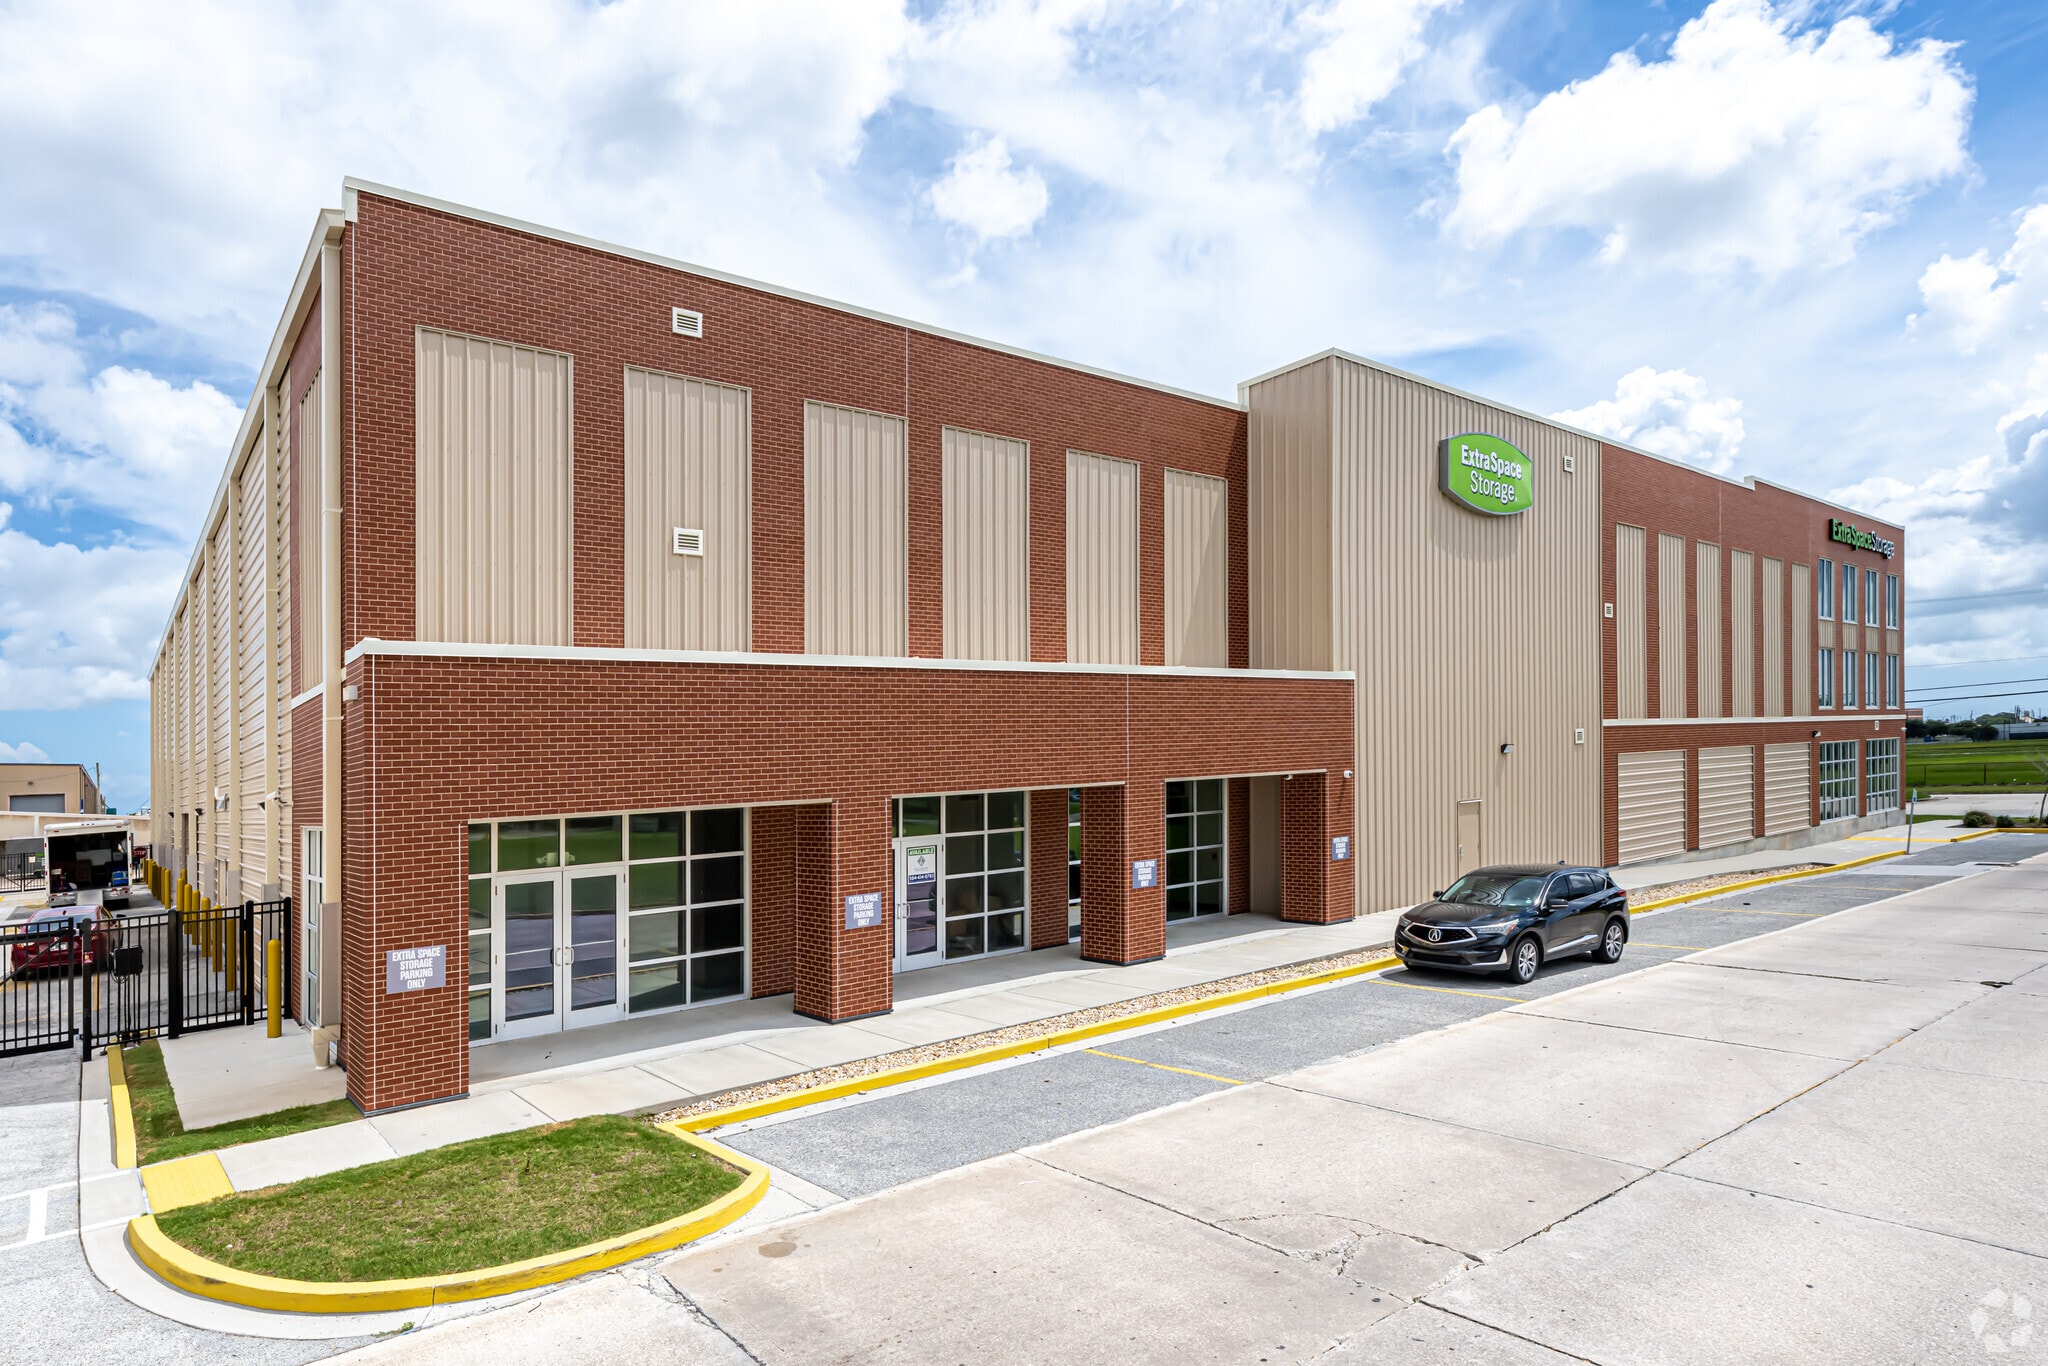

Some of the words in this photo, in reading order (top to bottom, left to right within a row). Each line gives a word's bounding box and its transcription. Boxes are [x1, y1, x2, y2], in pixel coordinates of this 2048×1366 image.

[1470, 470, 1516, 504] Storage
[848, 896, 864, 904] EXTRA
[863, 893, 879, 902] SPACE
[853, 902, 874, 911] STORAGE
[853, 909, 874, 919] PARKING
[392, 950, 416, 962] EXTRA
[417, 947, 441, 959] SPACE
[399, 958, 434, 971] STORAGE
[399, 967, 434, 981] PARKING
[406, 978, 427, 990] ONLY
